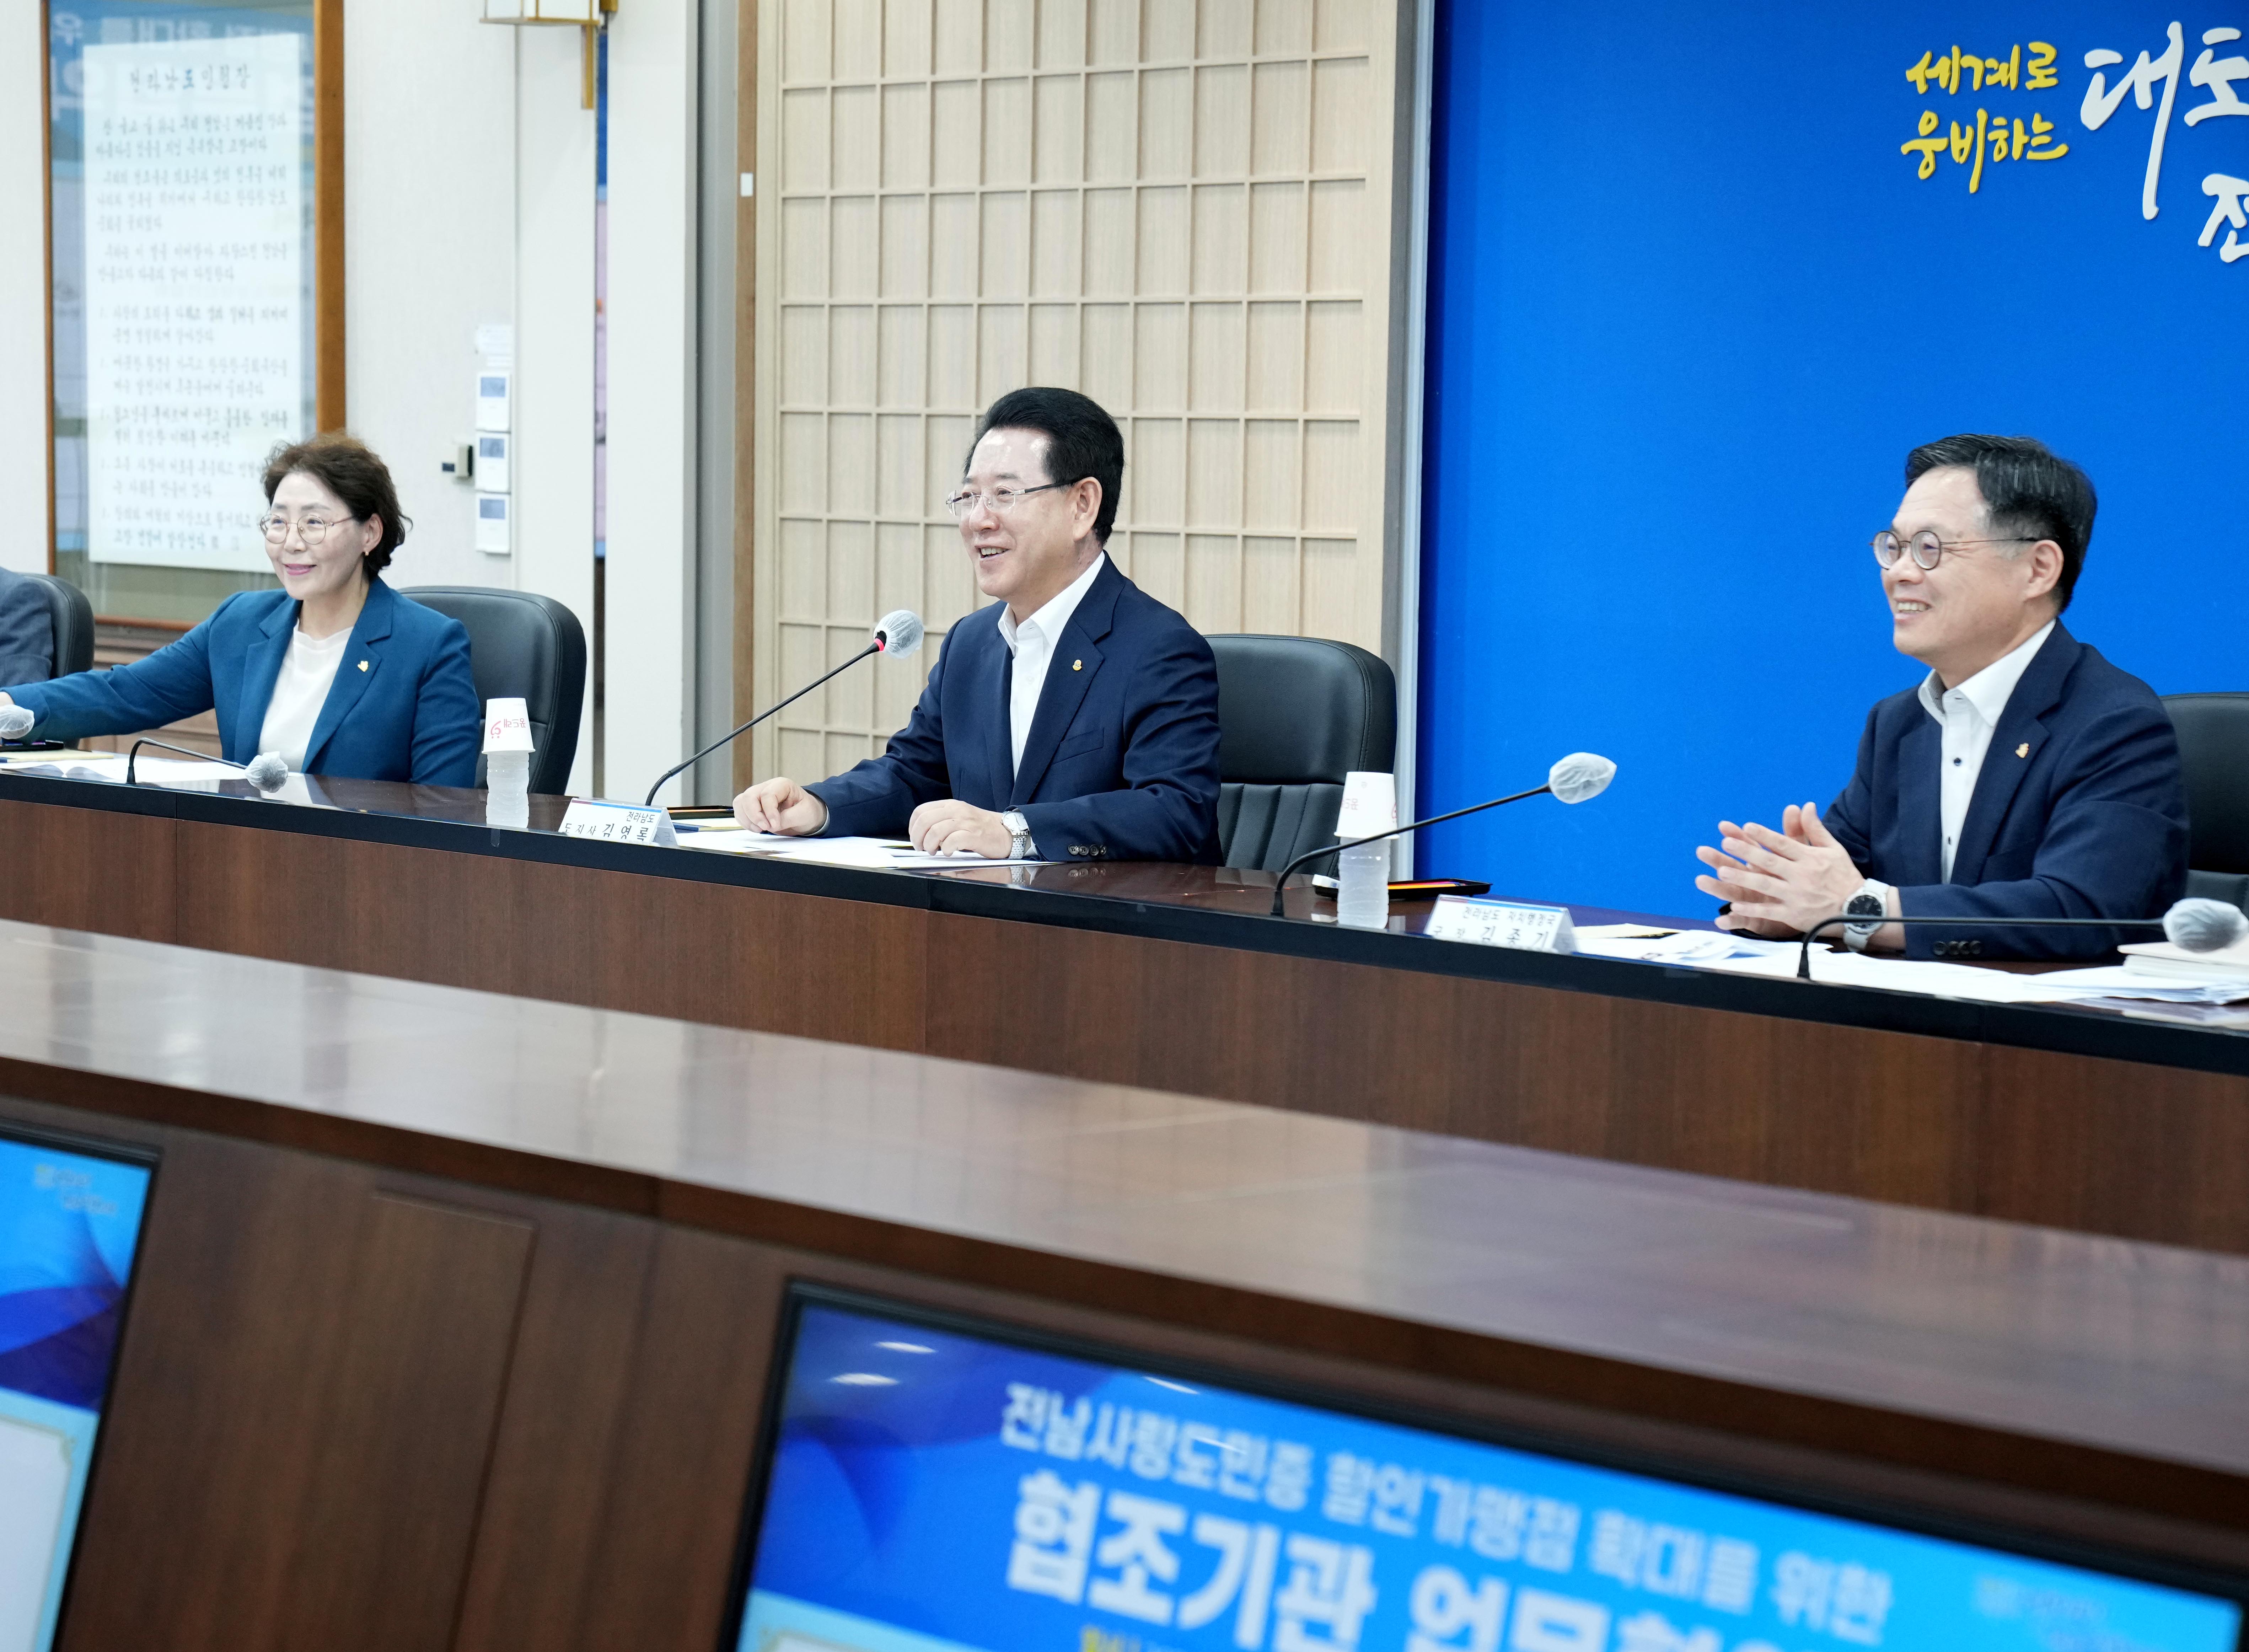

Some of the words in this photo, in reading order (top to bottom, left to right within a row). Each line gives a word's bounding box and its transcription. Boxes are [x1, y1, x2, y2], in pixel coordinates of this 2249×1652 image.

[1905, 41, 2059, 95] 세계로
[1900, 107, 2069, 194] 웅비하는
[503, 718, 526, 728] 꿈드래
[627, 811, 655, 823] 전라남도
[1000, 1382, 1315, 1511] 전남사랑도민증
[1322, 1450, 1580, 1573] 할인가맹점
[1587, 1509, 1761, 1616] 확대를
[1771, 1551, 1892, 1643] 위한
[1006, 1468, 1377, 1652] 협조기관
